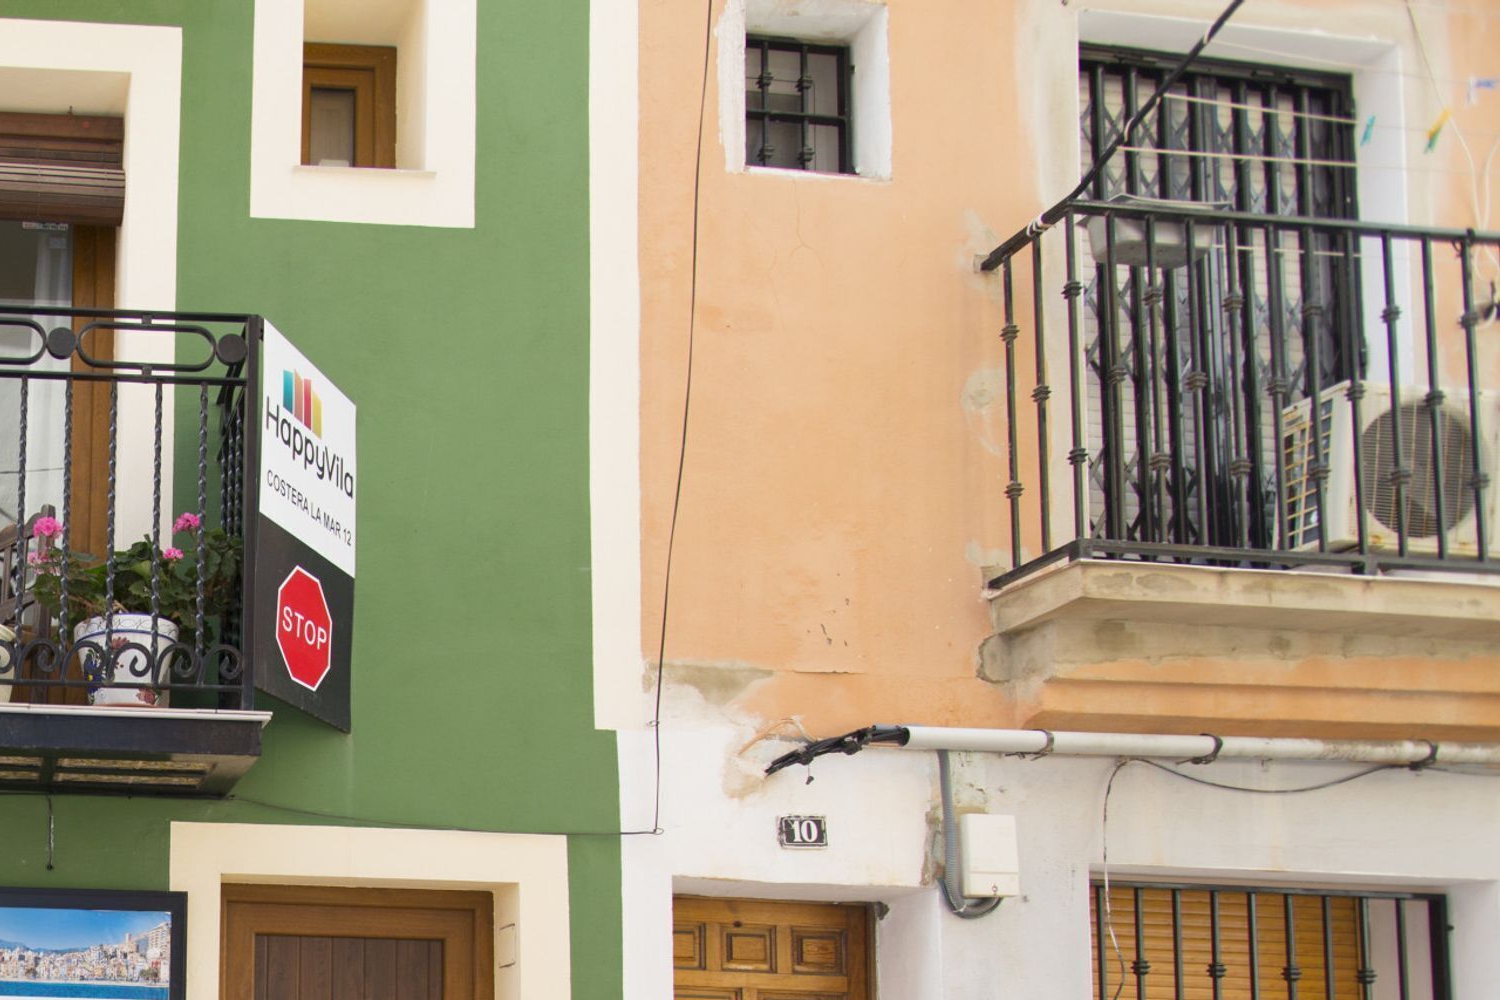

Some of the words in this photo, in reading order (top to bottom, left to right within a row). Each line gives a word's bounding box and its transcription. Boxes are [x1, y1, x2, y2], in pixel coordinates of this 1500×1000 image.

[266, 396, 354, 499] HappyVila
[267, 469, 309, 514] COSTERA
[310, 503, 322, 526] LA
[323, 512, 341, 539] MAR
[342, 527, 353, 547] 12
[282, 604, 328, 651] STOP
[790, 820, 818, 843] 10
